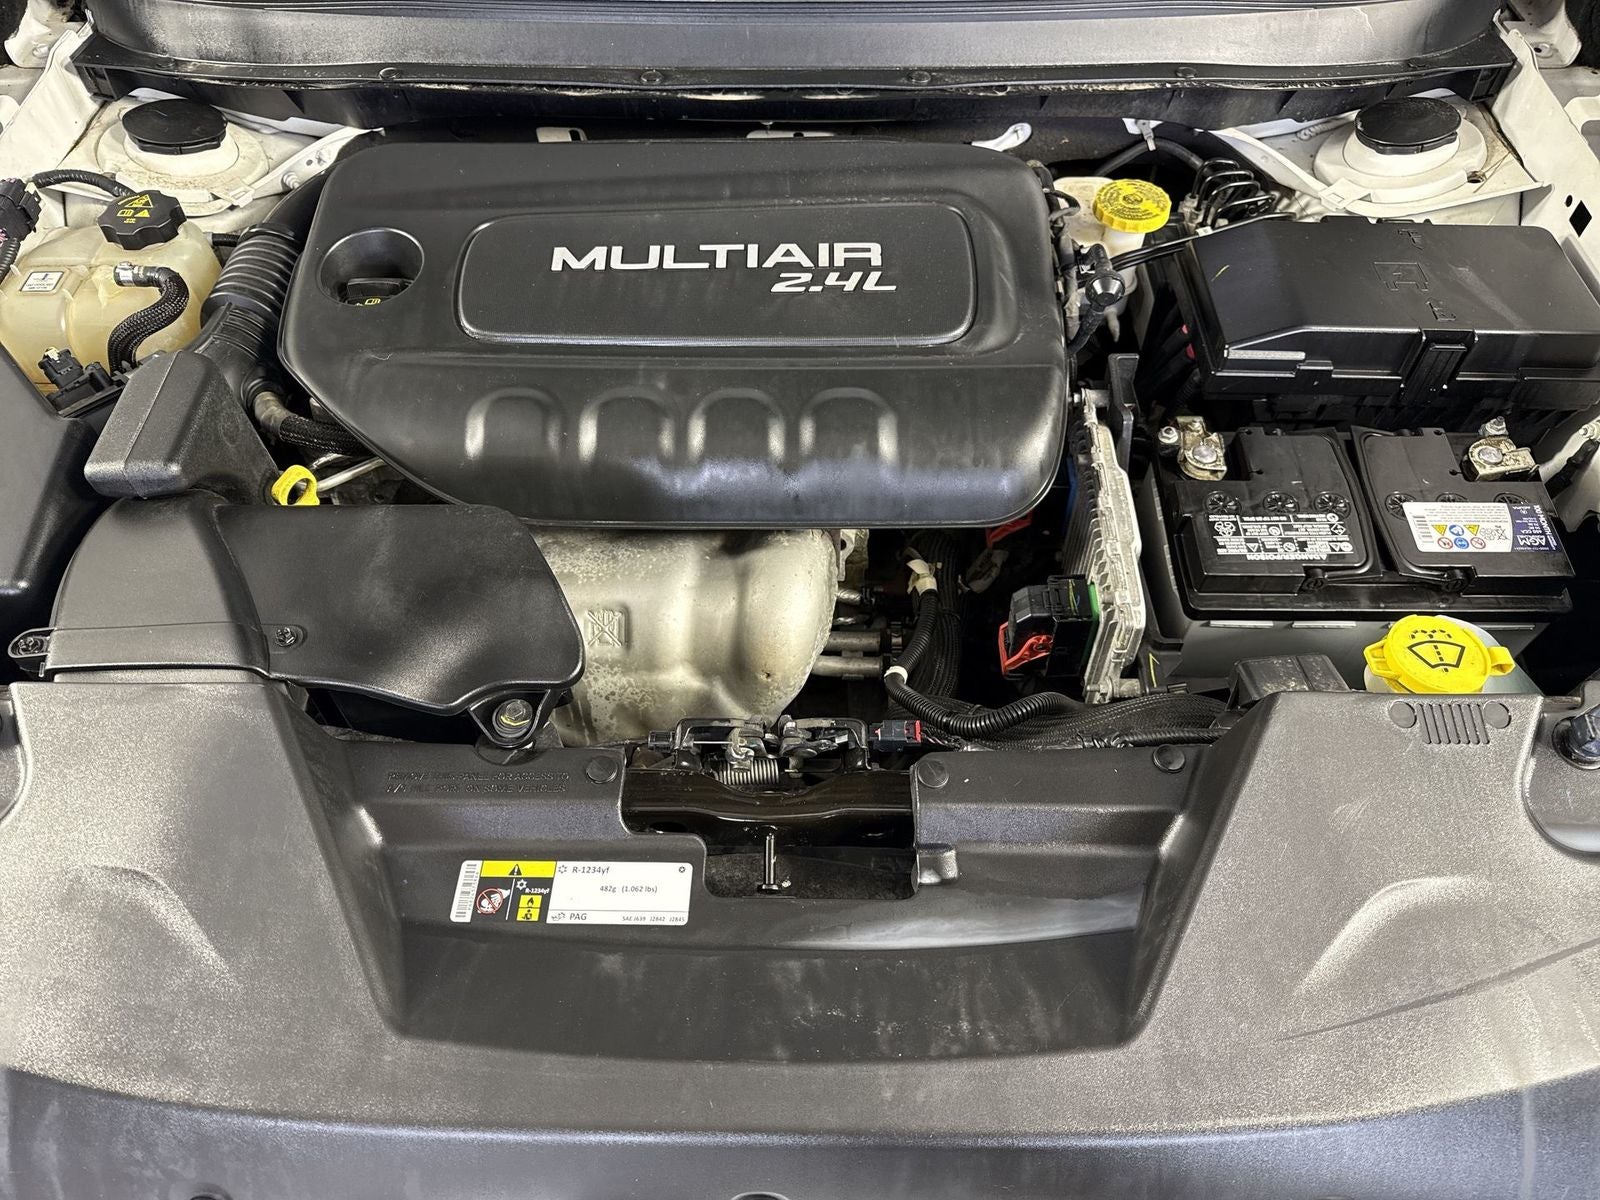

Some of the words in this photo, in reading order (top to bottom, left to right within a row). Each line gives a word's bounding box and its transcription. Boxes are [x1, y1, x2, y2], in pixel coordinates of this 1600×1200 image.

[551, 243, 882, 271] MULTIAIR
[771, 271, 896, 292] 2.4L
[1517, 536, 1546, 546] AGM
[517, 784, 566, 793] VEHICLES
[572, 866, 610, 876] R-1234yf
[599, 885, 617, 894] 482g
[621, 885, 644, 894] (1.062
[644, 885, 658, 894] lbs)
[569, 912, 588, 921] PAG
